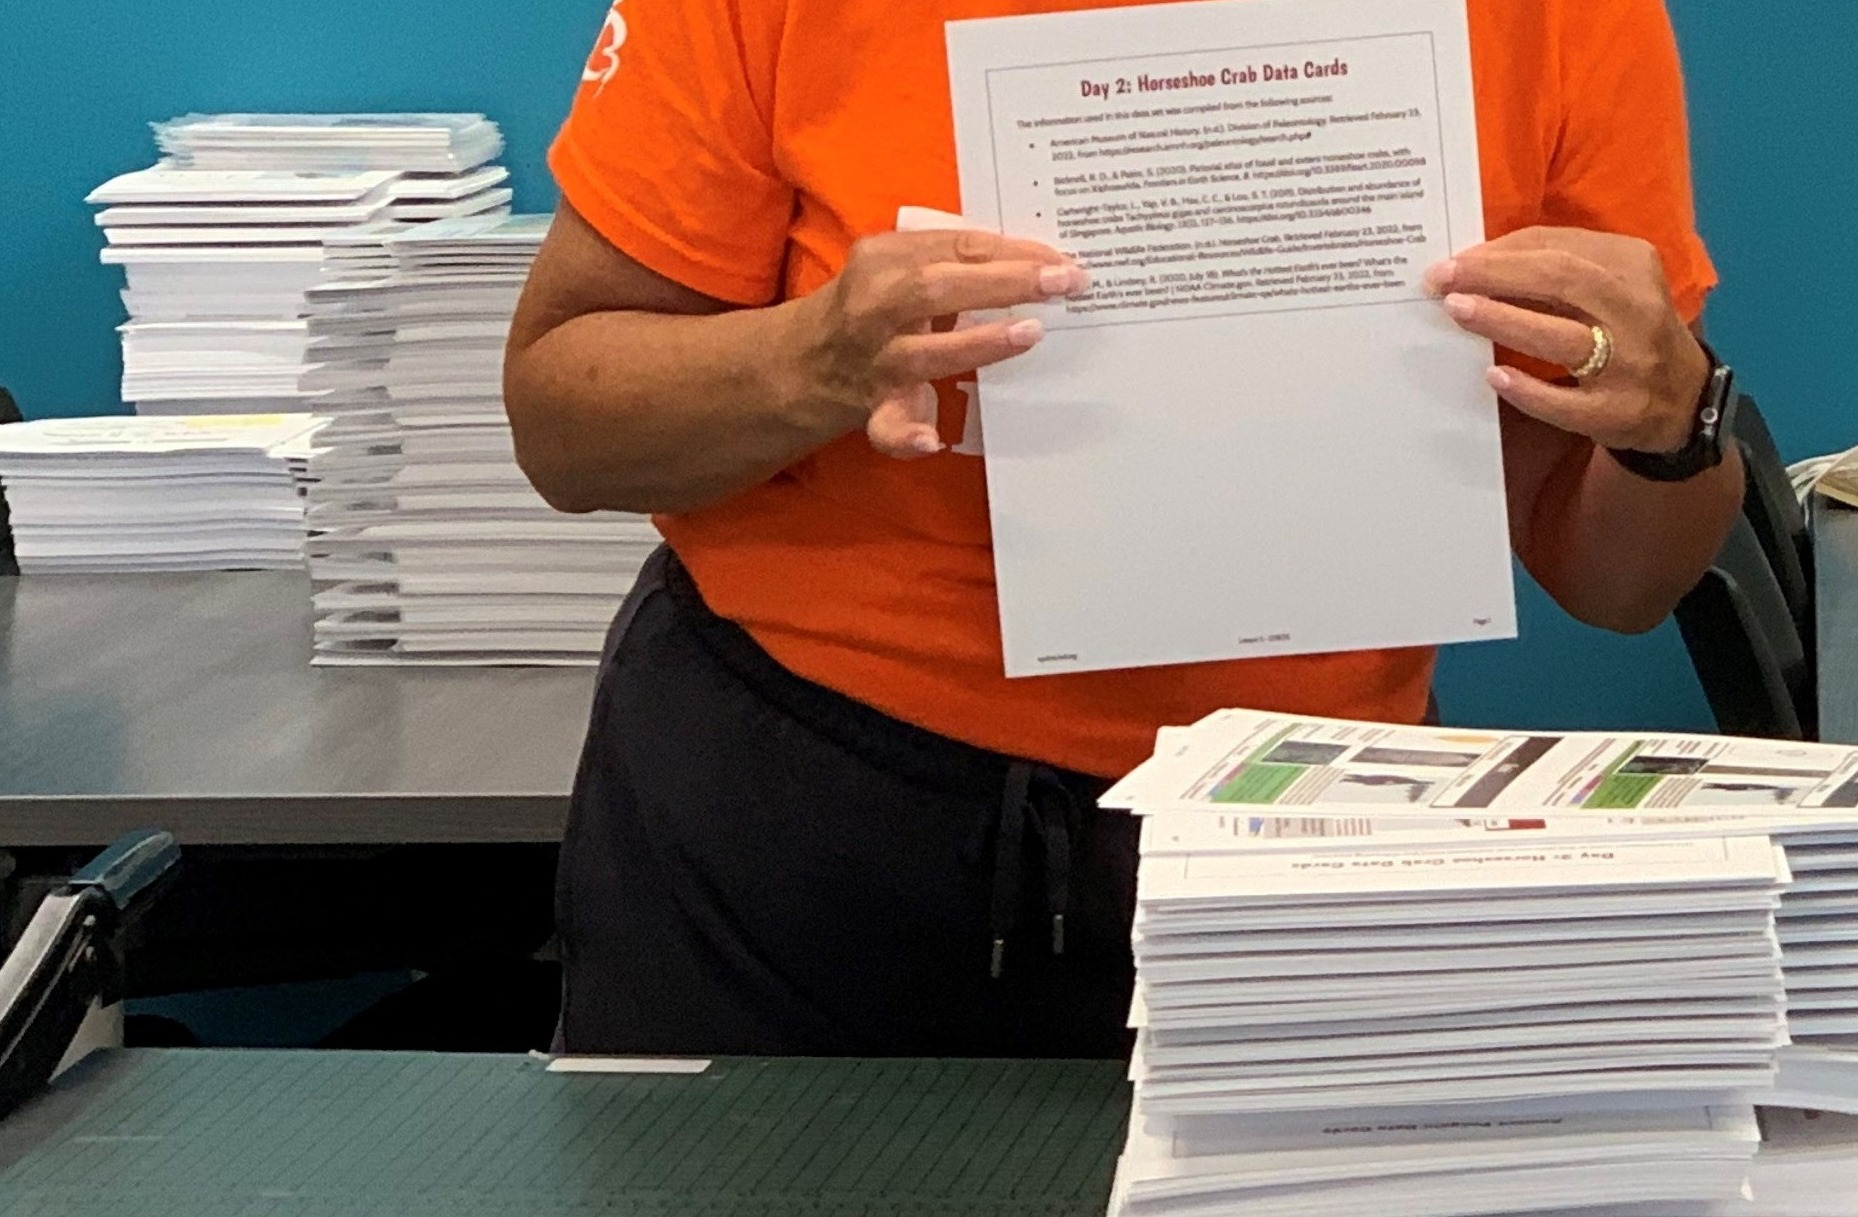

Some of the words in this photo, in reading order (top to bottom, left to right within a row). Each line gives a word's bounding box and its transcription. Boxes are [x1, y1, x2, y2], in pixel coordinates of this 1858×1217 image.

[1081, 79, 1110, 101] Day
[1116, 78, 1132, 94] 2:
[1138, 70, 1216, 92] Horseshoe
[1221, 65, 1257, 86] Crab
[1263, 63, 1298, 82] Data
[1304, 57, 1348, 78] Cards
